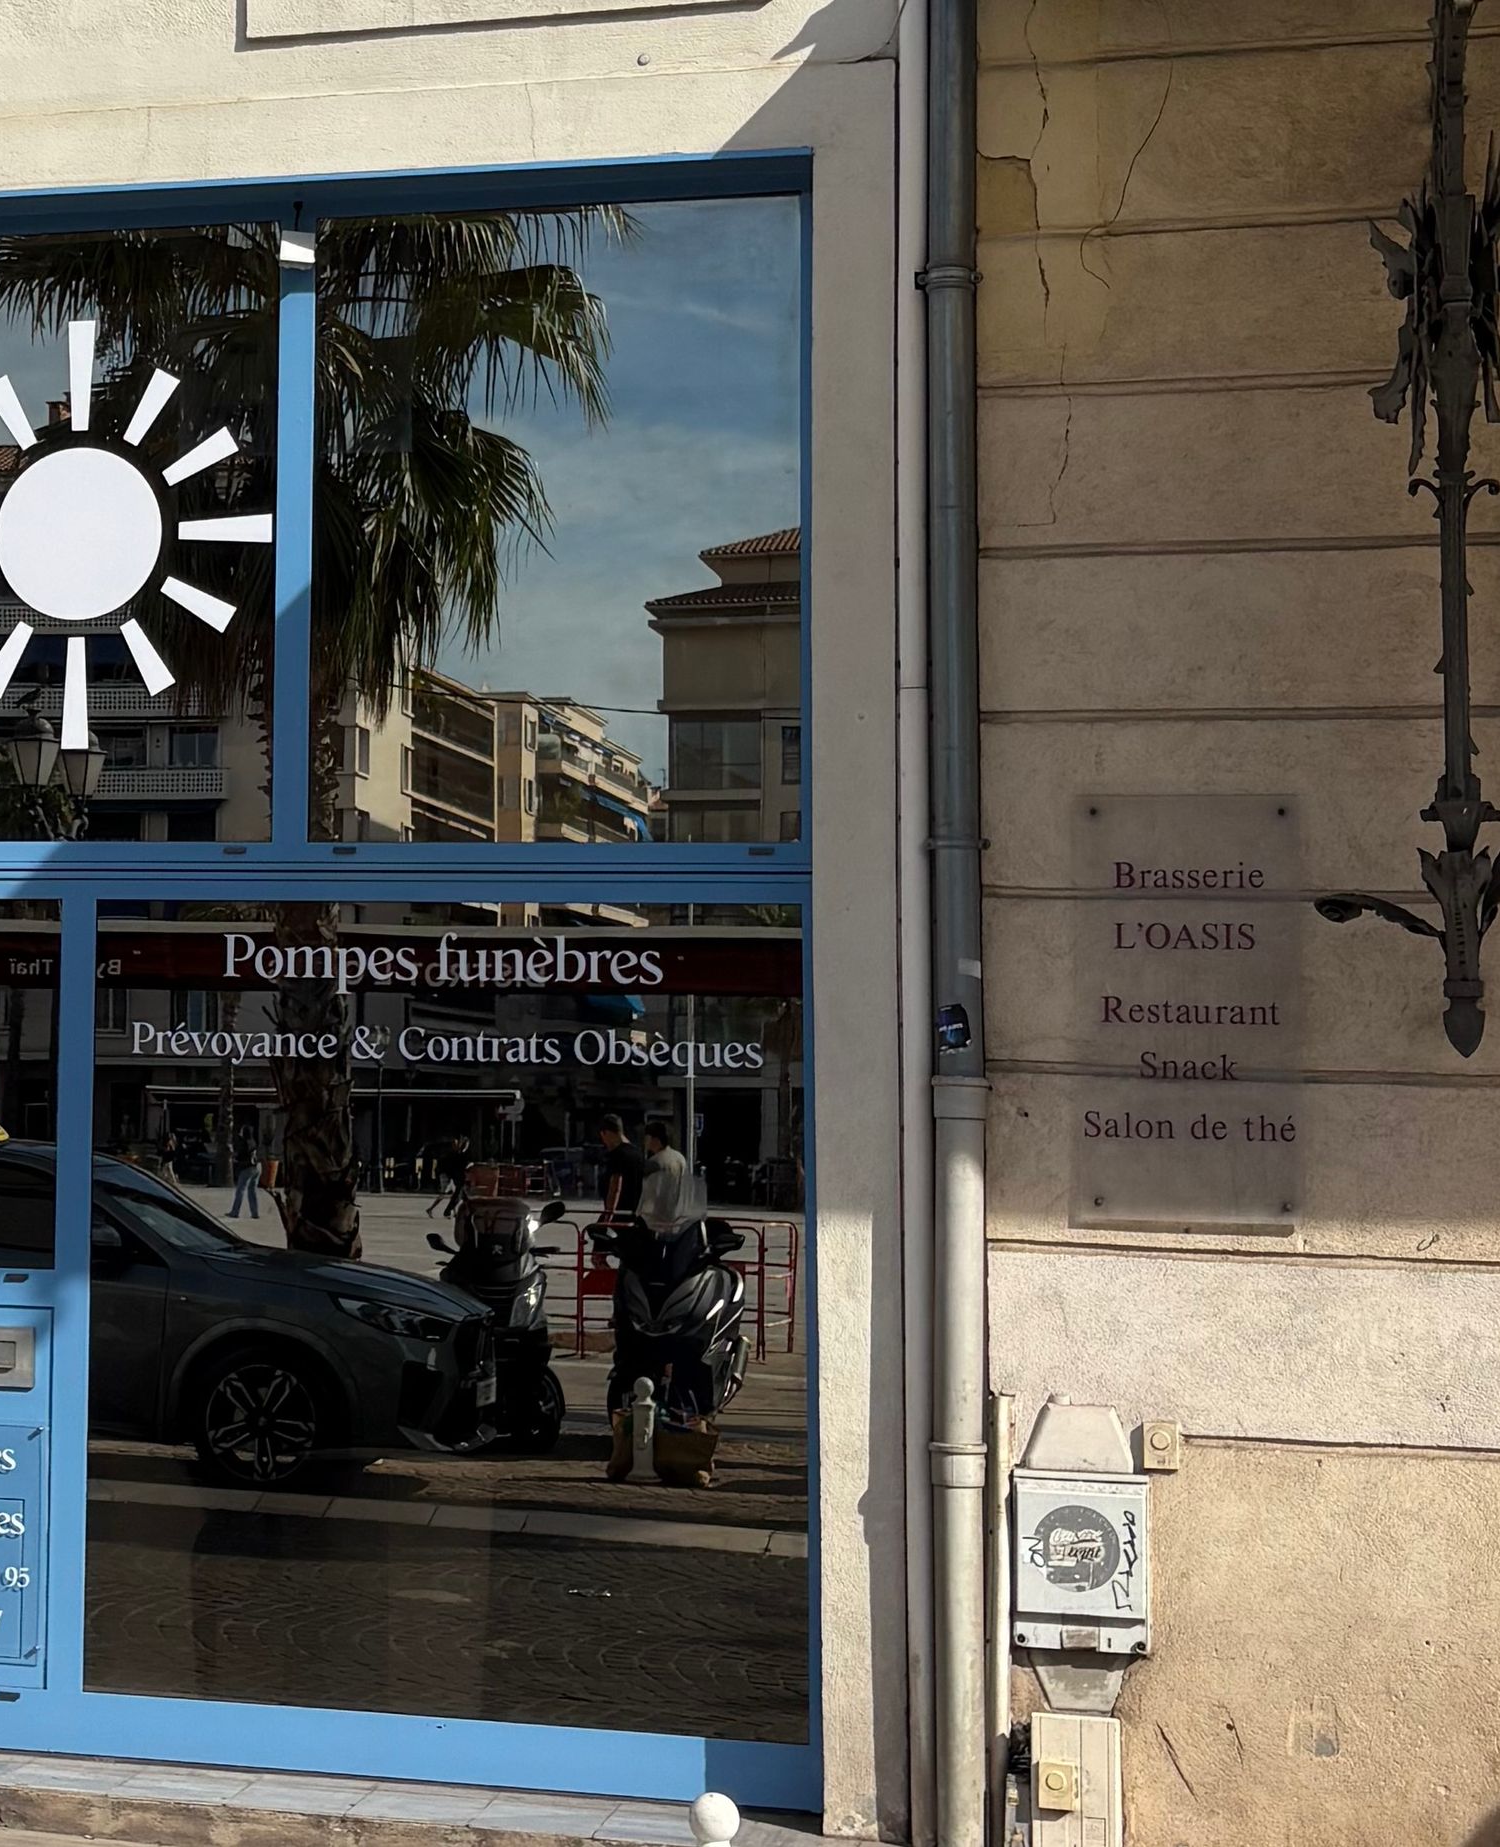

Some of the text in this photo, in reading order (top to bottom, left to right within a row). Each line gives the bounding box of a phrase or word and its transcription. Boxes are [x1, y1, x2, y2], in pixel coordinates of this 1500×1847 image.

[1113, 861, 1265, 889] Brasserie
[1114, 922, 1256, 950] L'OASIS
[222, 934, 419, 994] Pompes
[436, 931, 663, 985] funèbres
[1101, 996, 1280, 1025] Restaurant
[132, 1021, 764, 1078] Prévoyance & Contrats Obsèques
[1140, 1051, 1238, 1080] Snack
[1084, 1111, 1296, 1141] Salon de thé
[4, 1566, 31, 1588] 95
